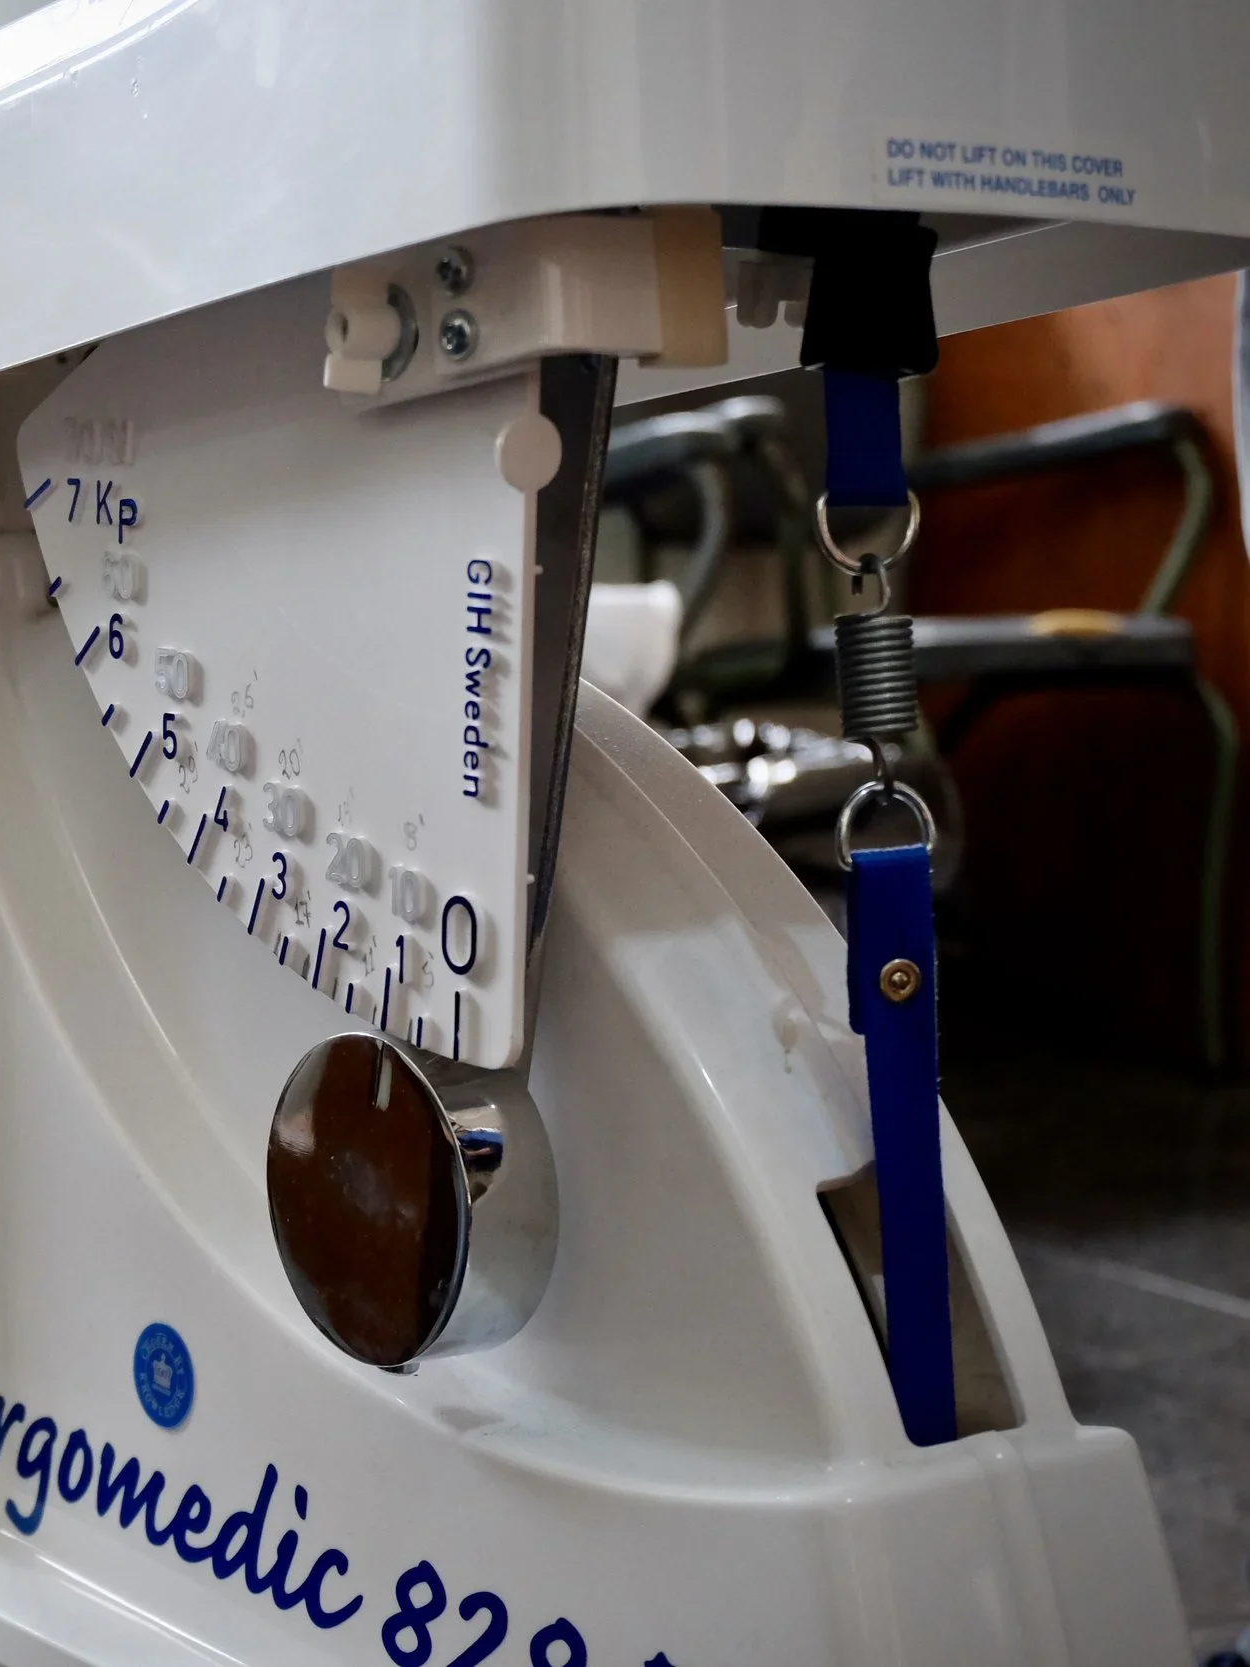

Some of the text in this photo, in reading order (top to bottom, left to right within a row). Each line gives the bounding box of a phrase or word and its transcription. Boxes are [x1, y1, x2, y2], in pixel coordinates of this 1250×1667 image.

[886, 138, 1123, 178] DO NOT LIFT ON THIS COVER
[887, 168, 1136, 205] LIFT WITH HANDLEBARS ONLY
[67, 477, 139, 544] 7 Kp
[108, 613, 124, 659] 6
[462, 559, 493, 799] GIH Sweden
[162, 712, 178, 760] 5
[213, 785, 229, 832] 4
[262, 782, 300, 837] 30
[271, 851, 287, 900] 3
[325, 832, 366, 889] 20
[332, 900, 350, 950] 2
[441, 895, 478, 976] 0
[395, 934, 405, 984] 1
